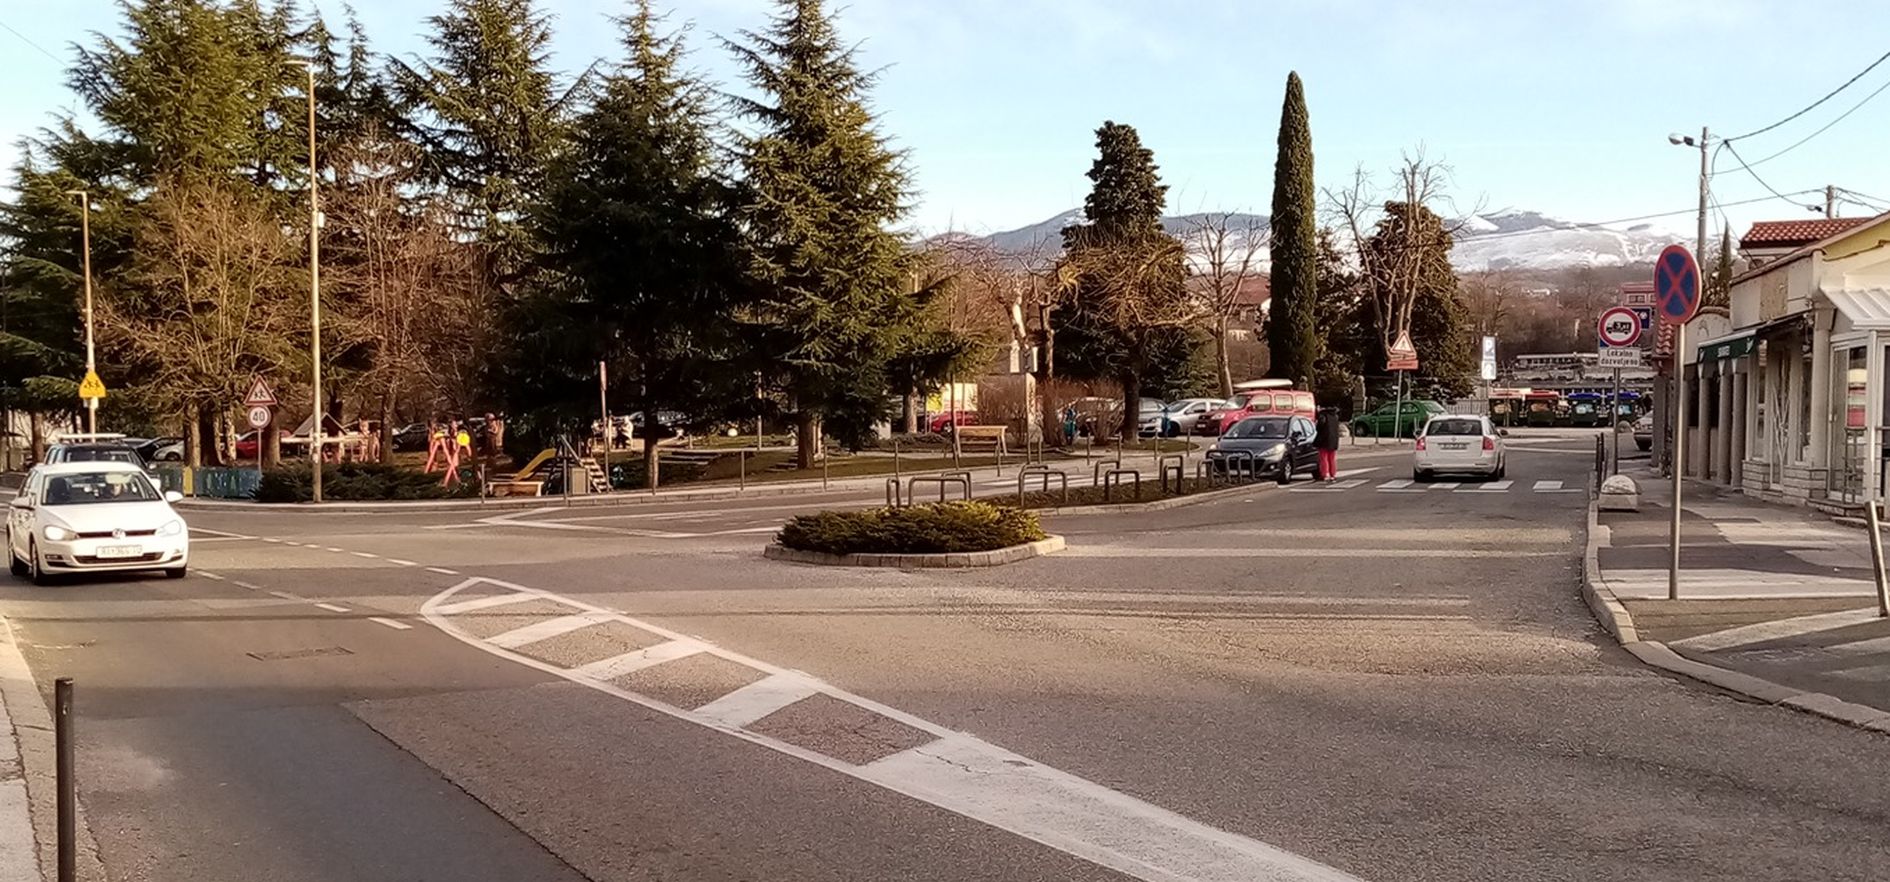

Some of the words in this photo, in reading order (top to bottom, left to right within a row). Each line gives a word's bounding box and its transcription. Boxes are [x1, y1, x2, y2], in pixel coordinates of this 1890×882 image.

[1607, 349, 1633, 357] Lokalno
[1601, 357, 1638, 366] dozvoljeno
[253, 411, 265, 422] 40
